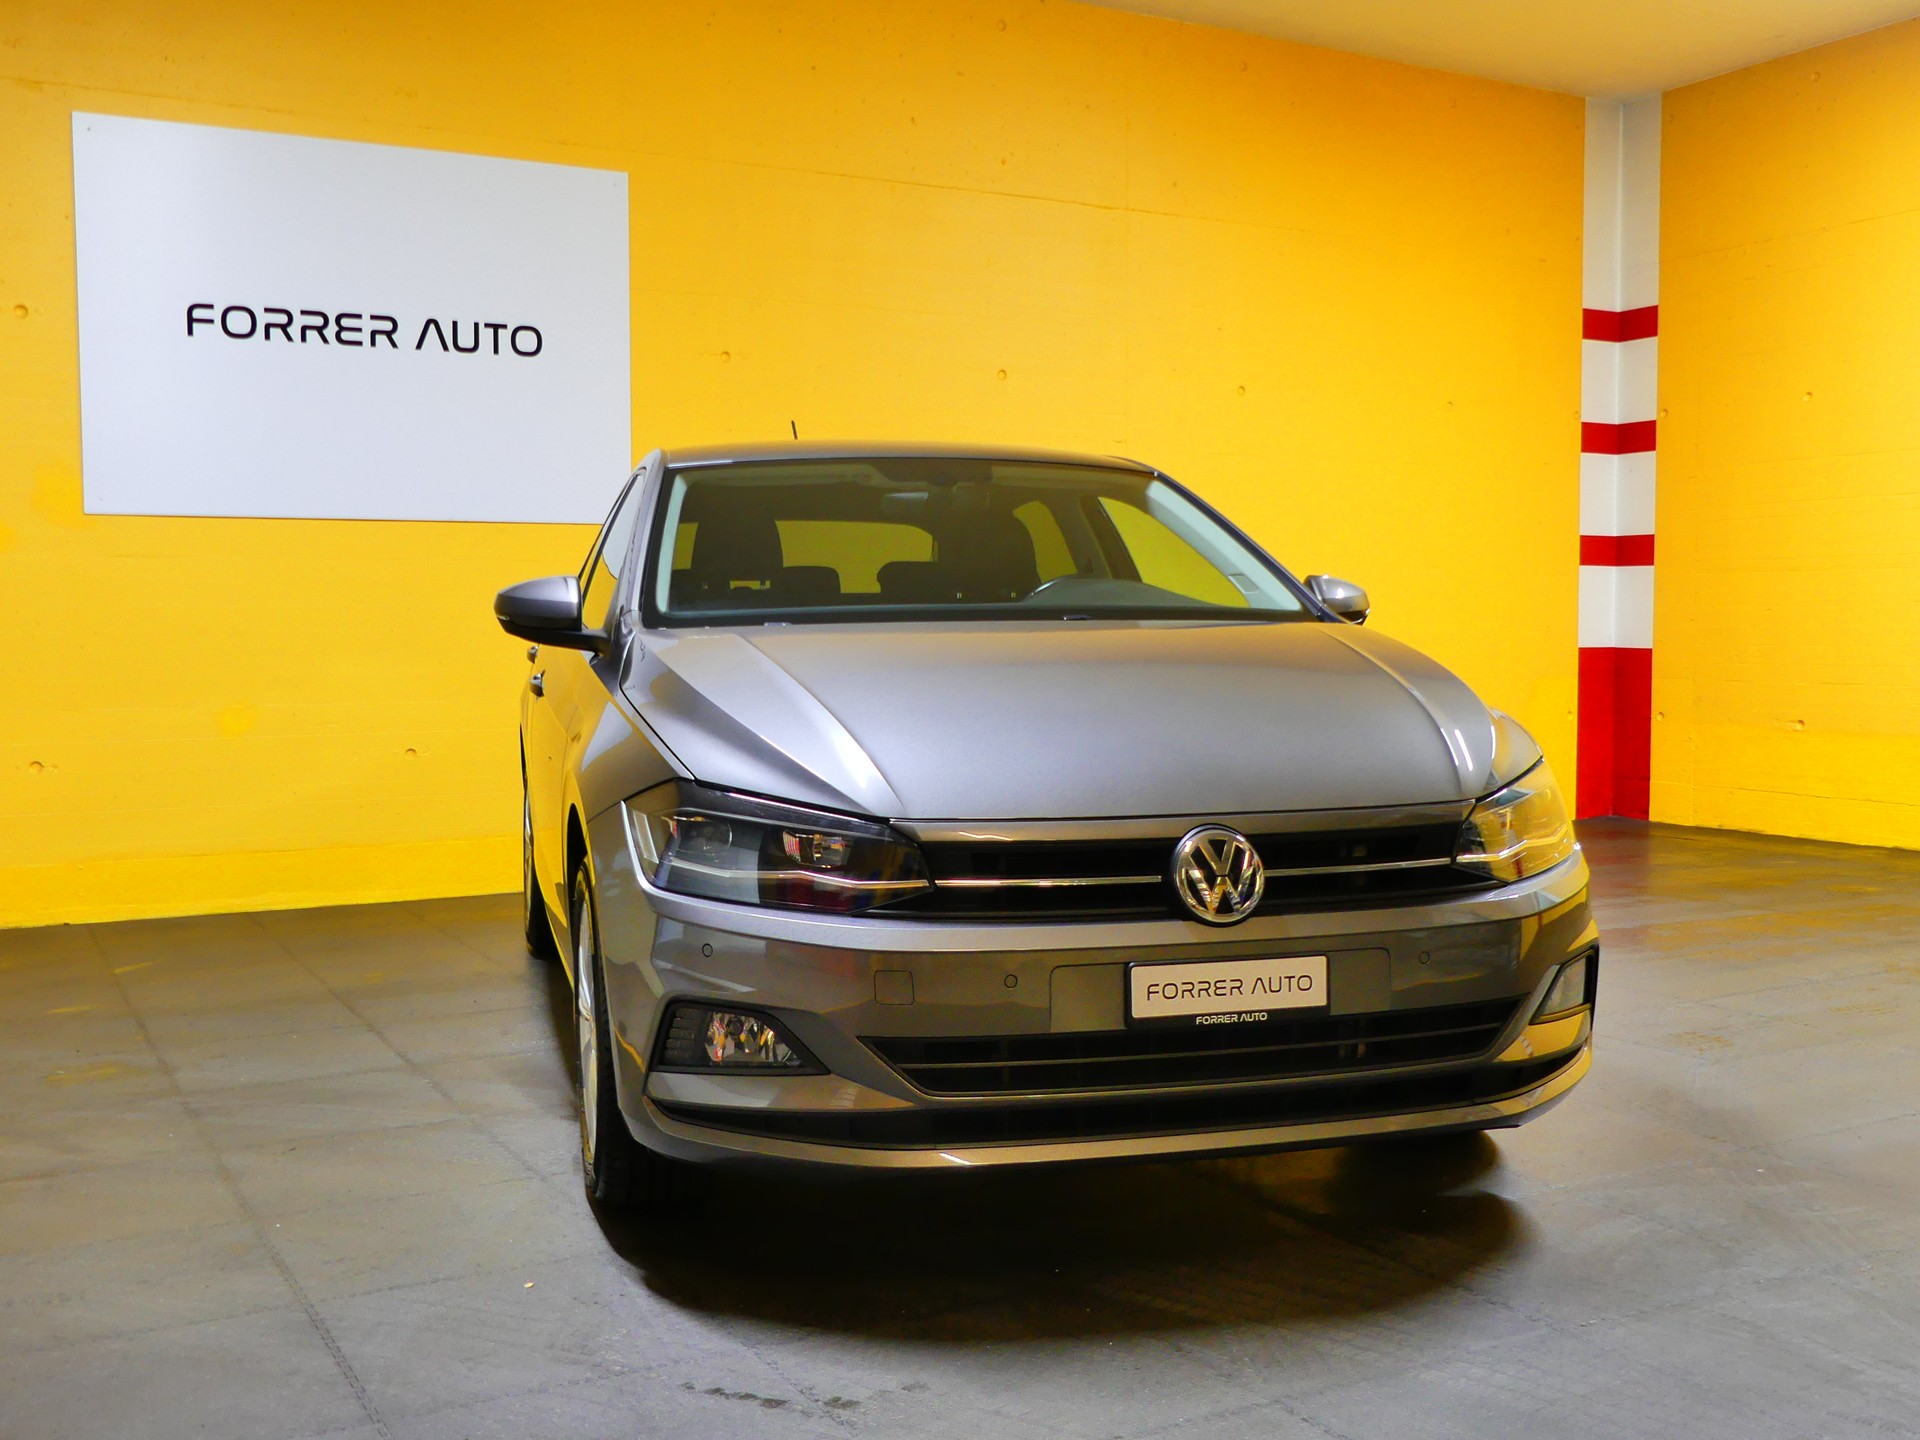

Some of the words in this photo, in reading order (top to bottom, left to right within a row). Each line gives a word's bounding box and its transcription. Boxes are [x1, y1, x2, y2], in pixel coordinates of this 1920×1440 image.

[186, 303, 399, 349] FORRER
[415, 318, 543, 357] AUTO
[1147, 978, 1244, 1001] FORRER
[1250, 974, 1313, 995] AUTO
[1195, 1014, 1239, 1025] FORRER
[1239, 1012, 1268, 1022] AUTO
